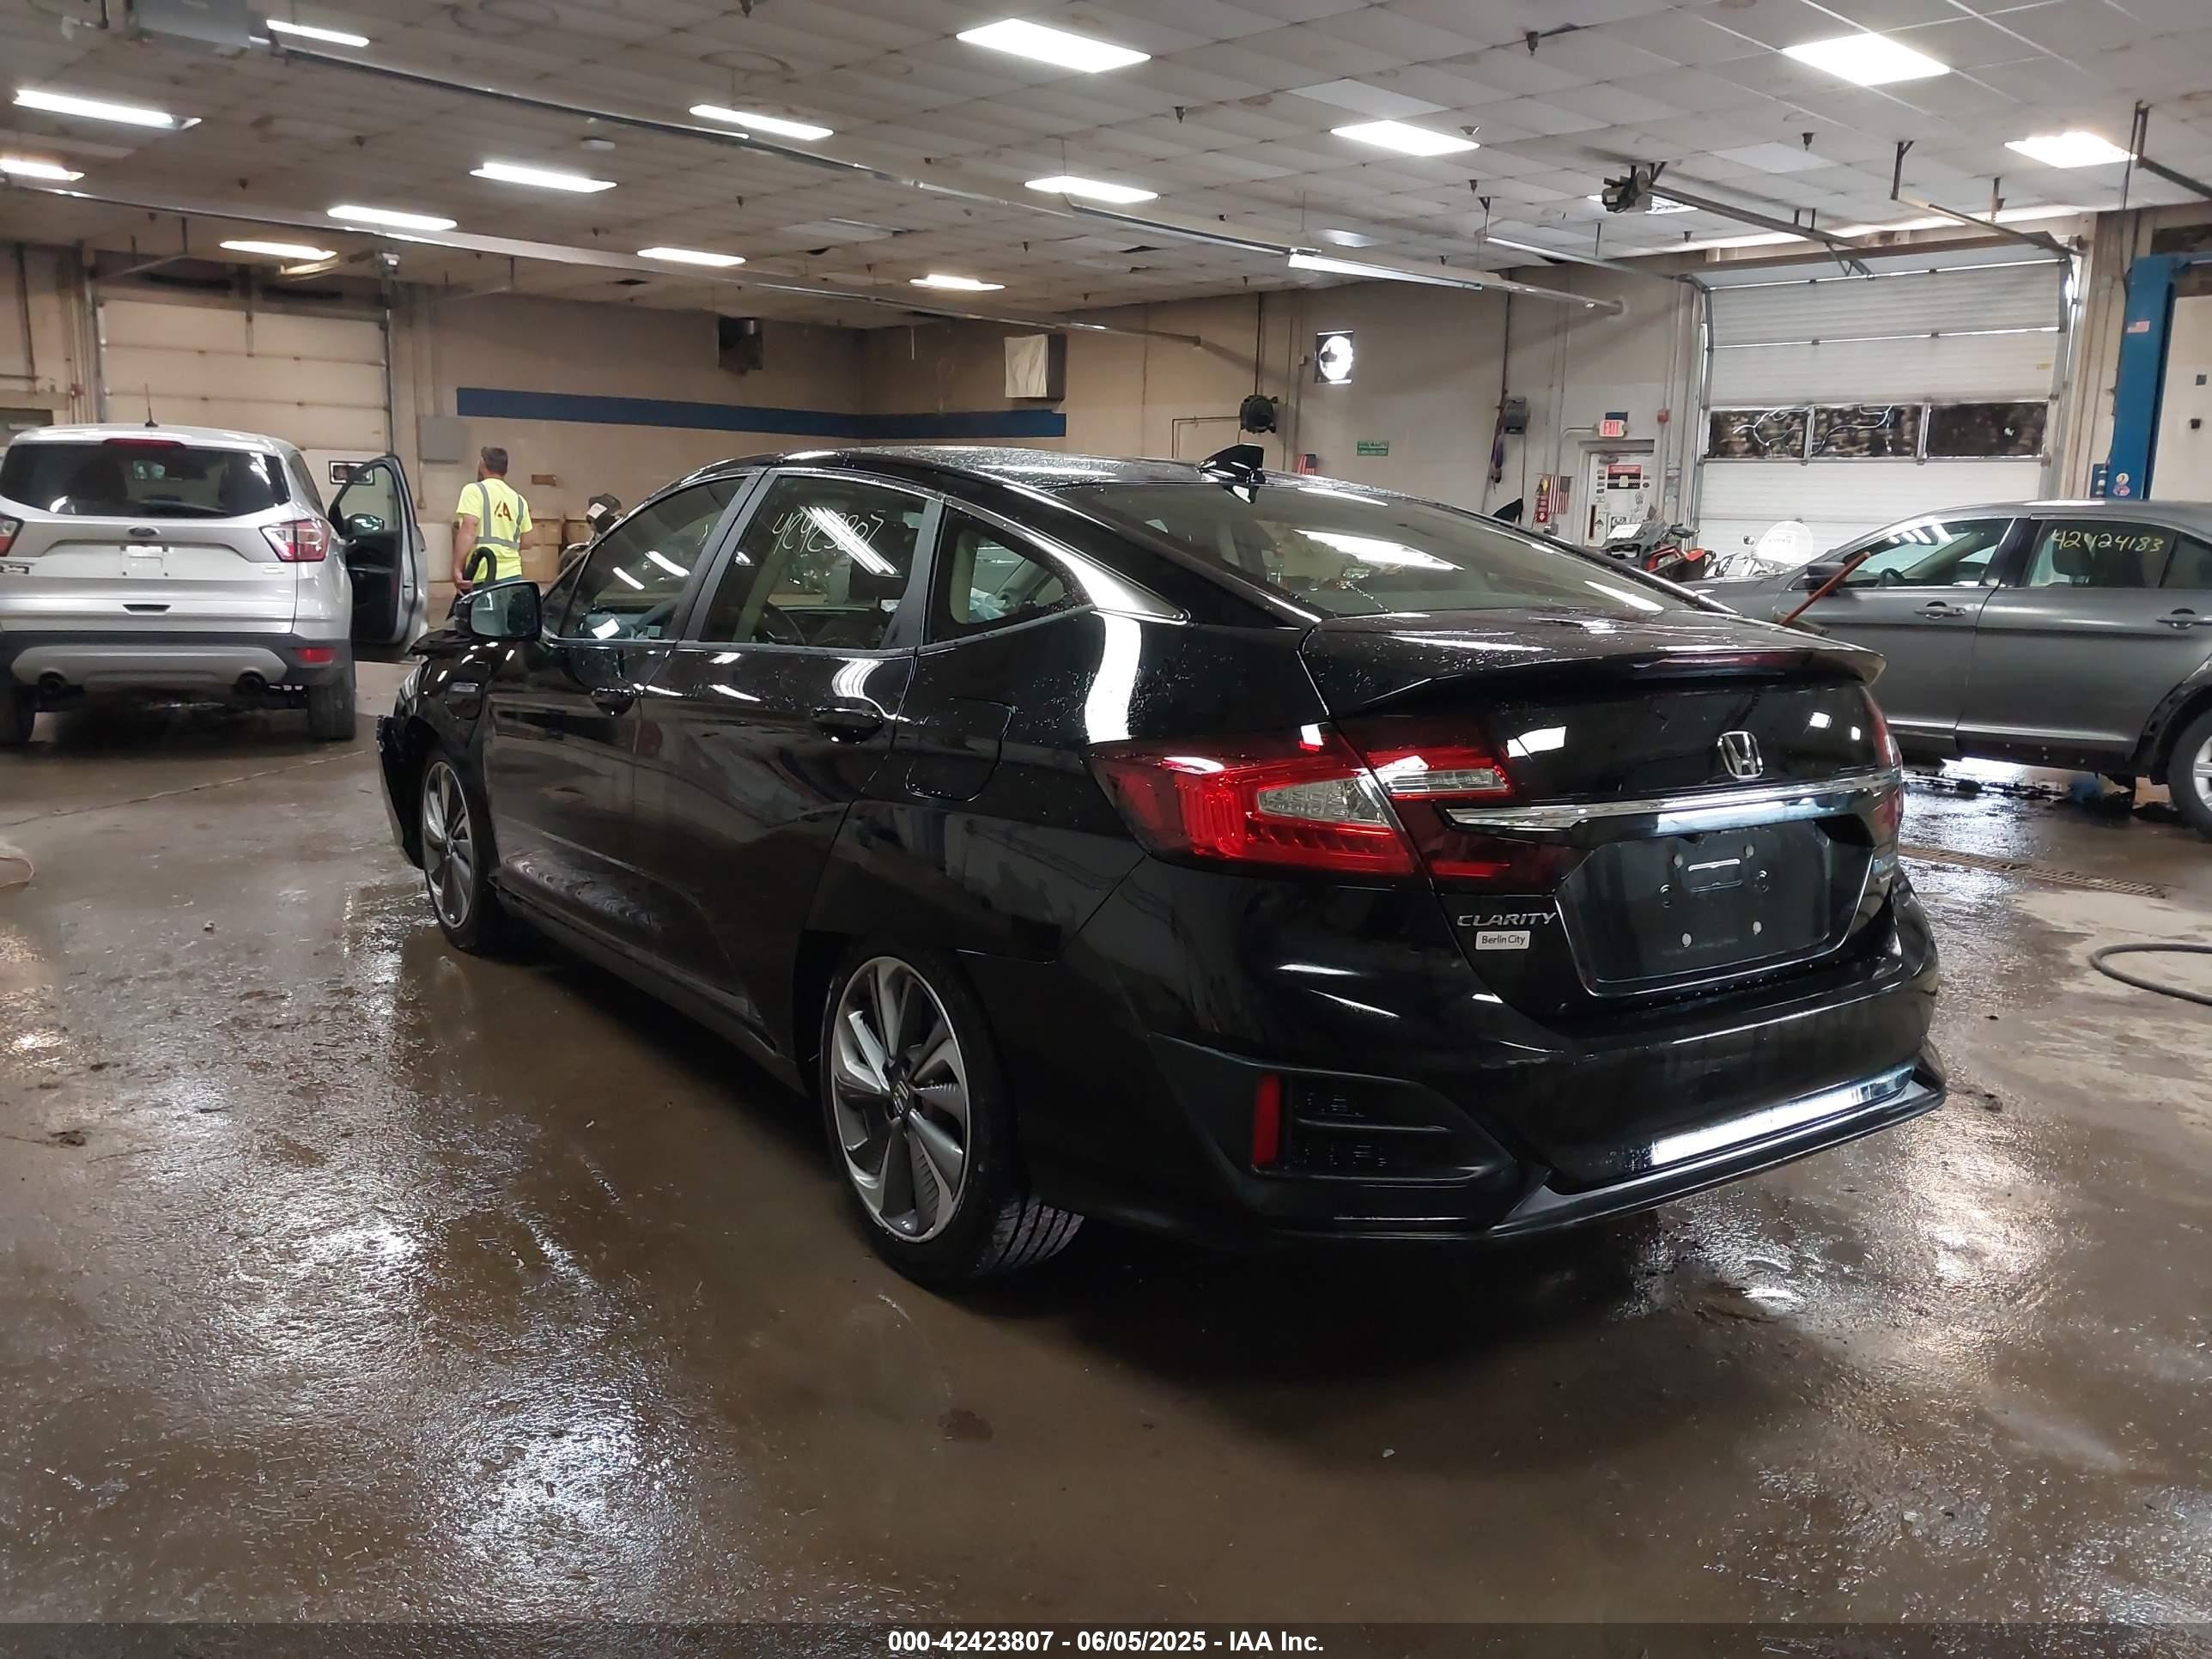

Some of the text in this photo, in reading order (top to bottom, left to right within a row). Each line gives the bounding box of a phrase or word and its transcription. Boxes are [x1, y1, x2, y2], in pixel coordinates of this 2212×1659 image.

[2051, 528, 2165, 552] 42424183
[1457, 912, 1557, 927] CLARITY
[1481, 934, 1526, 945] Berlin City
